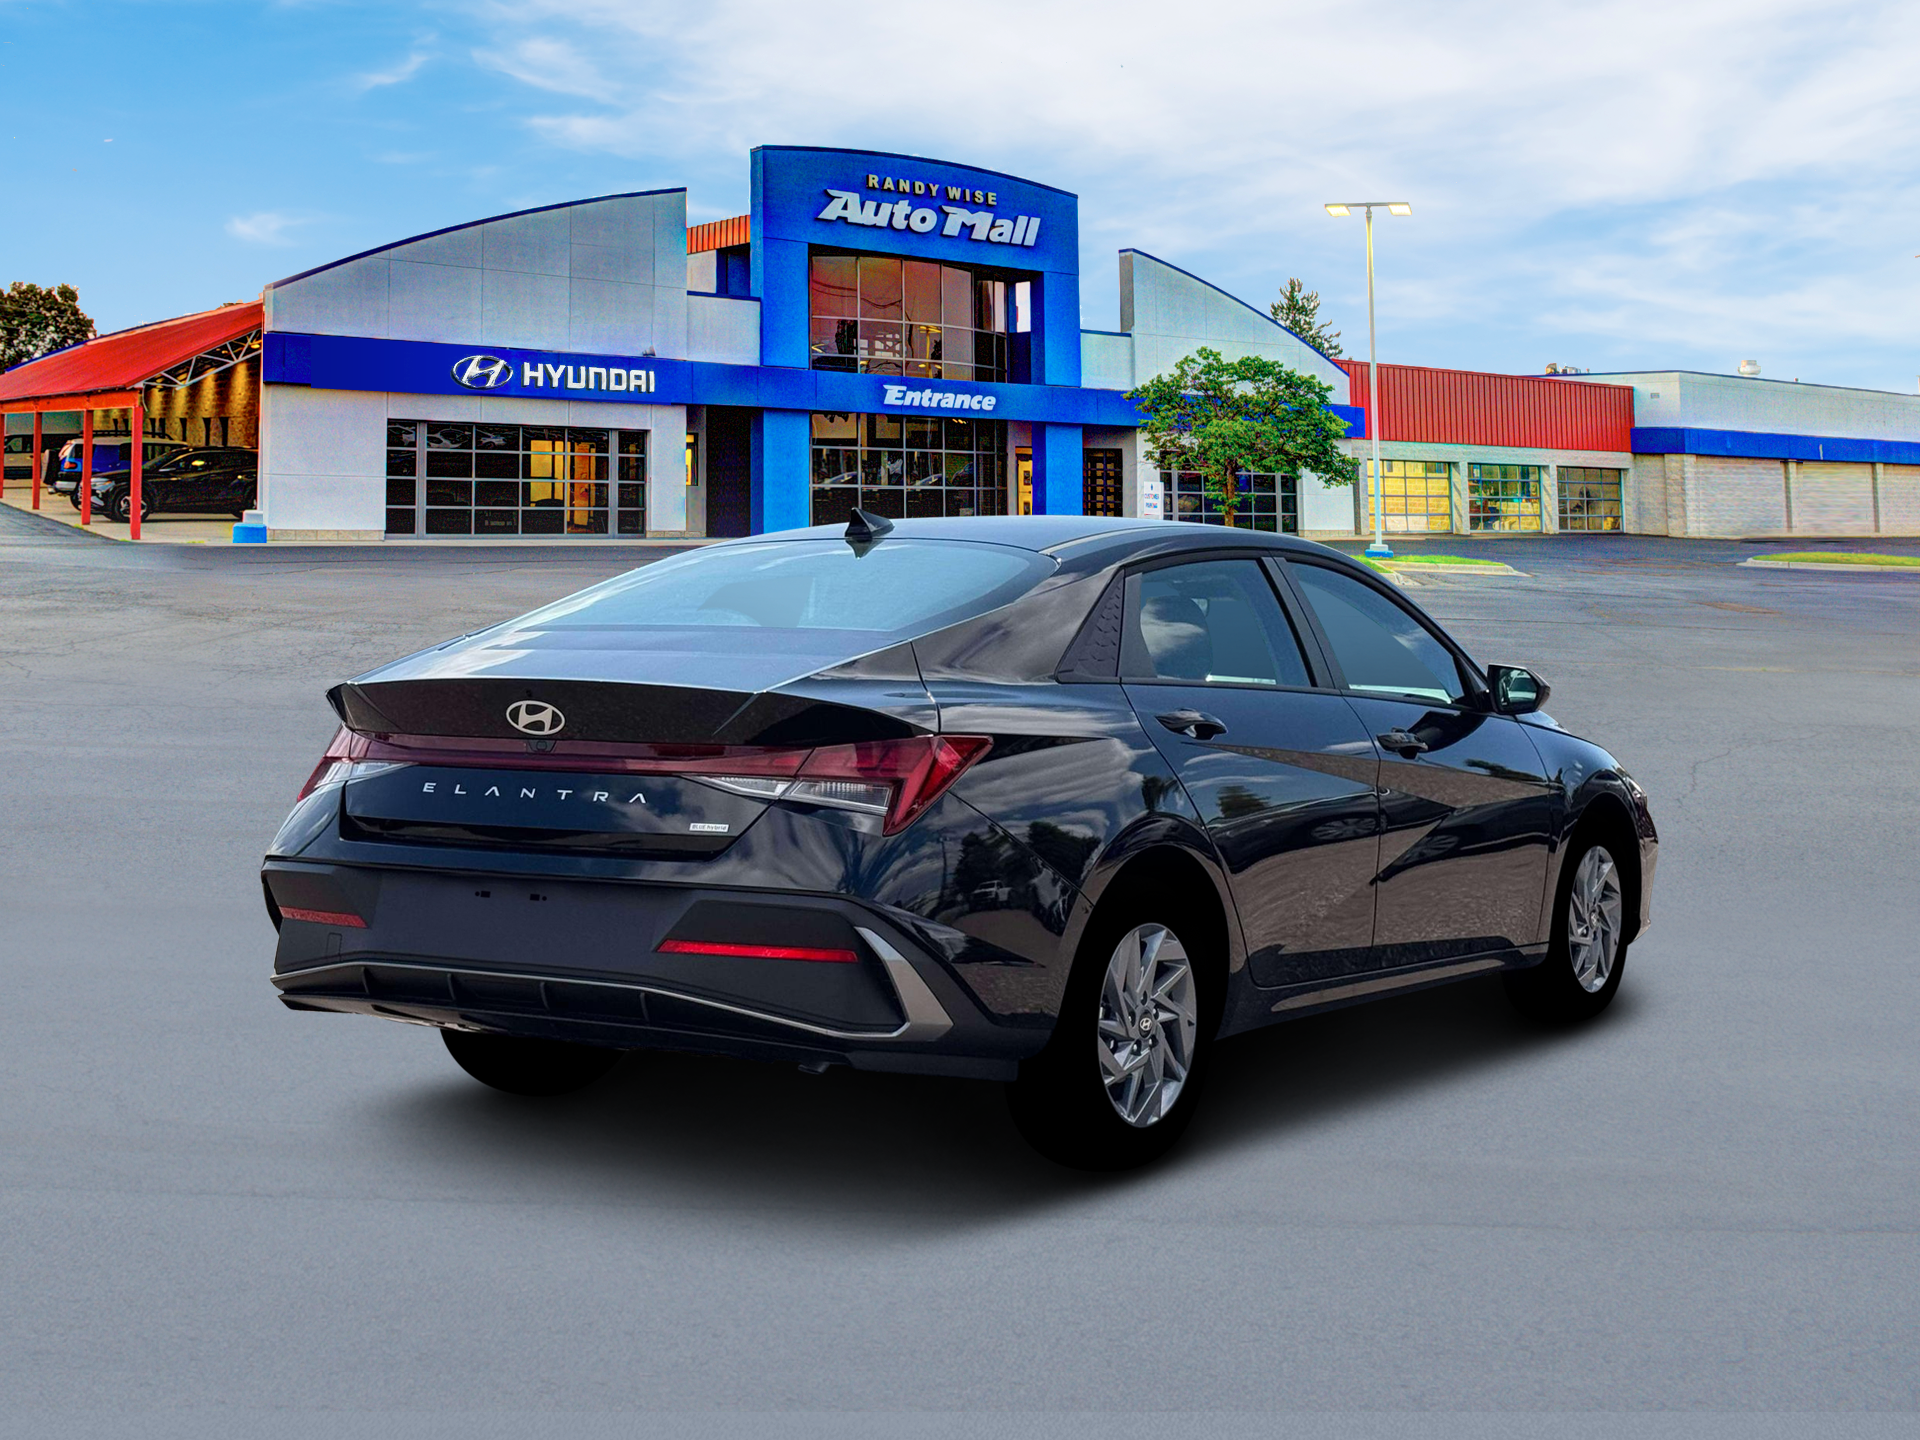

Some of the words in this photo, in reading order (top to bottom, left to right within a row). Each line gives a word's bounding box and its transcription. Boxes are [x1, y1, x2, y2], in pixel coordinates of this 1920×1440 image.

[866, 173, 940, 198] RANDY
[945, 185, 998, 206] WISE
[816, 188, 938, 233] Auto
[940, 205, 1042, 247] Mall
[522, 361, 656, 393] HYUNDAI
[882, 384, 997, 411] Entrance
[422, 782, 647, 804] ELANTRA
